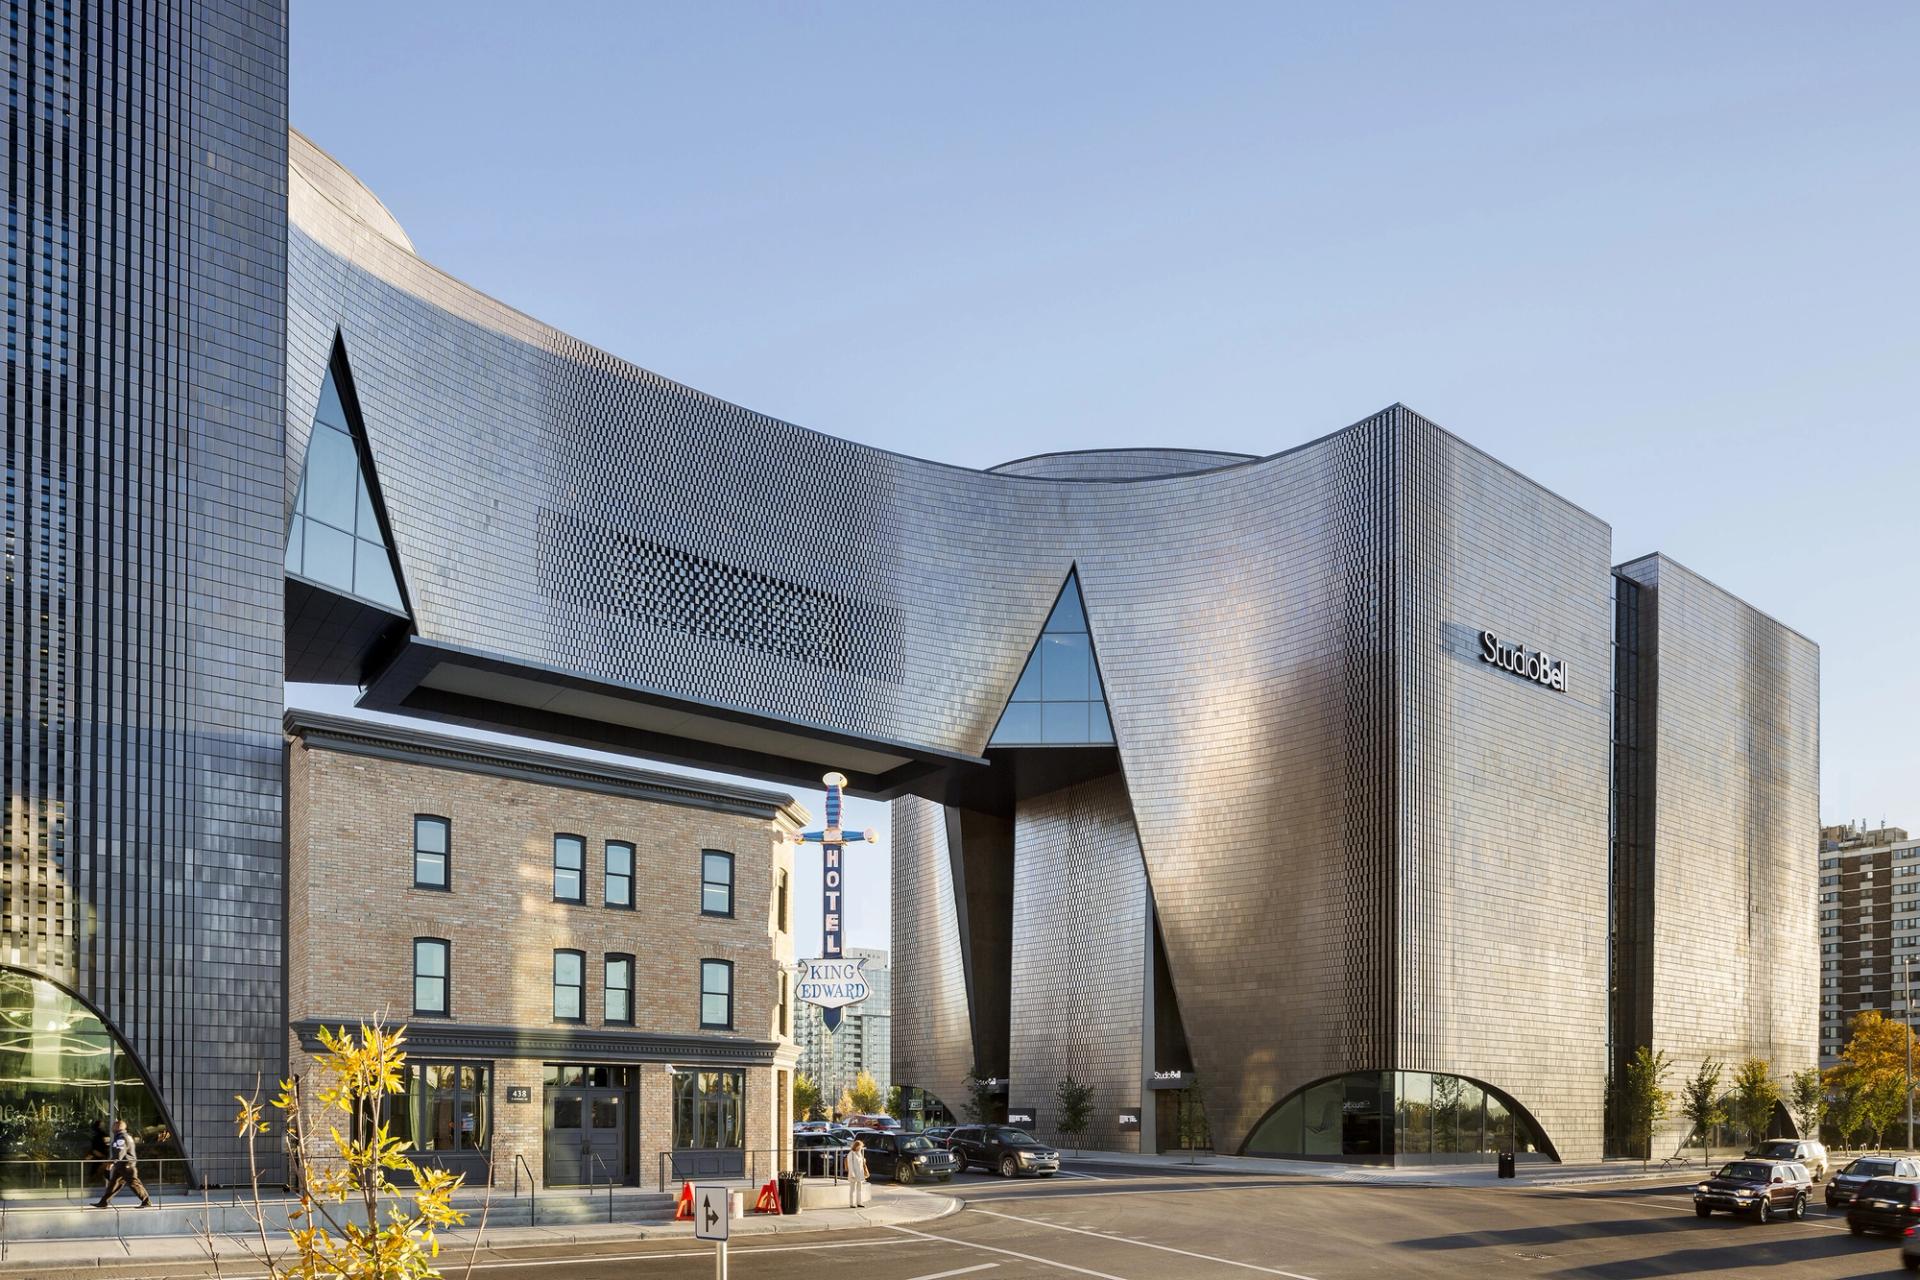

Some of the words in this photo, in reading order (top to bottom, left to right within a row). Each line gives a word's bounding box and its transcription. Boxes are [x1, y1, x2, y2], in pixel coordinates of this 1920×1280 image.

[1481, 630, 1569, 693] StudioBell
[825, 849, 840, 953] HOTEL
[801, 983, 865, 998] EDWARD
[810, 964, 855, 979] KING
